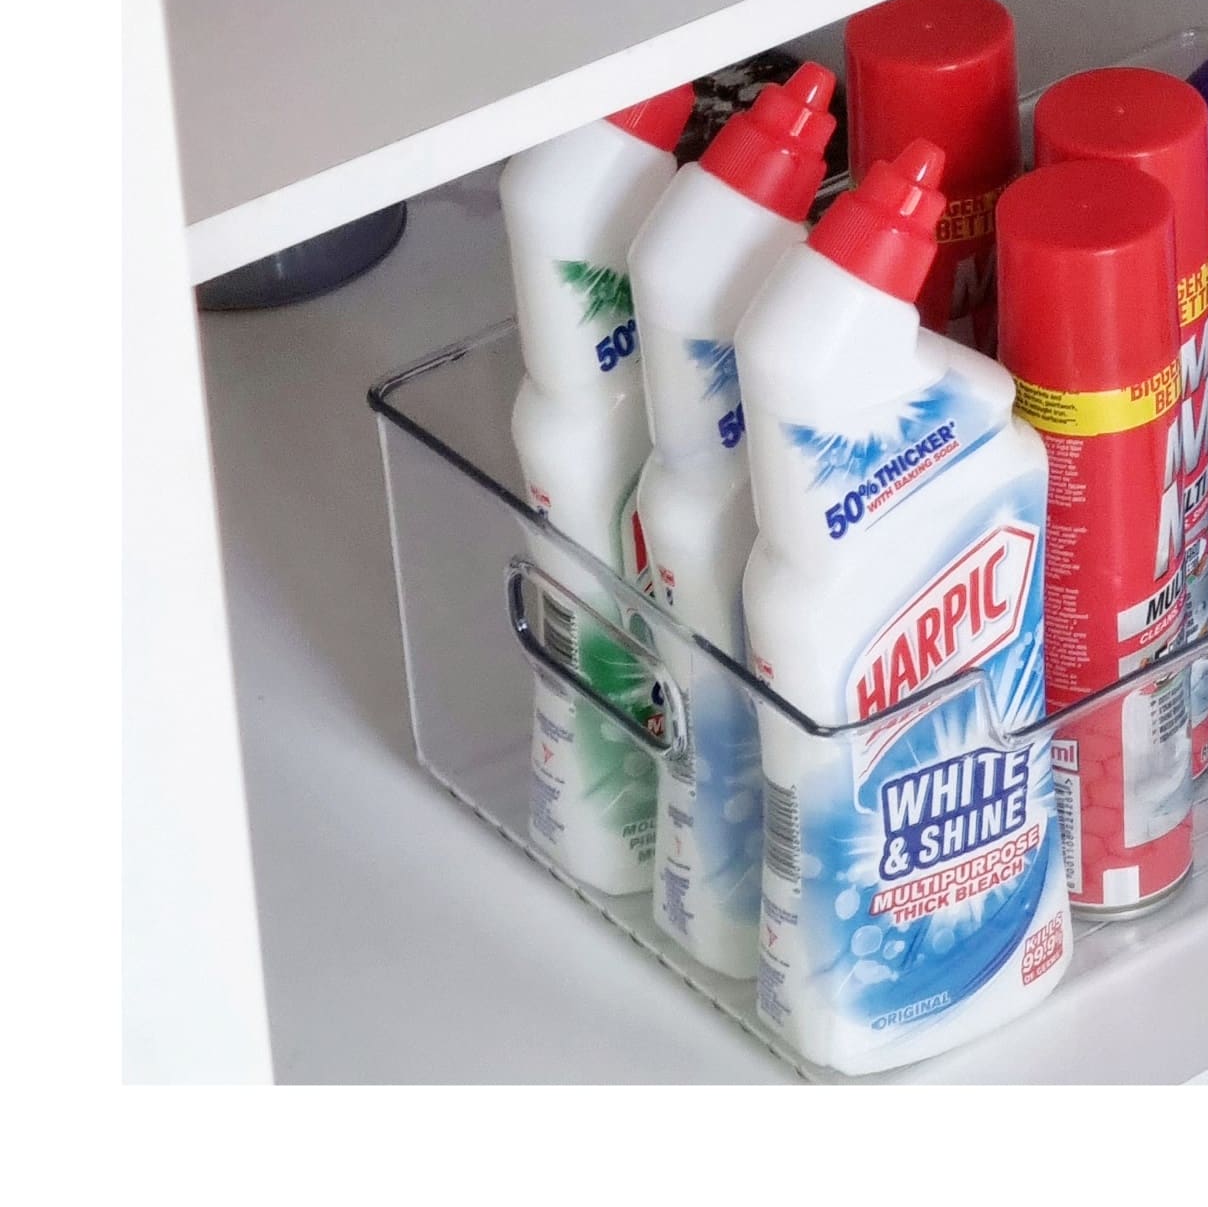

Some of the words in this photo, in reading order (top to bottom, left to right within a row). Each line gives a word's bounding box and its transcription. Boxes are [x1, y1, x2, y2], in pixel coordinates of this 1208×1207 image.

[825, 480, 878, 539] 50%
[867, 487, 894, 513] WITH
[894, 459, 932, 491] BAKING
[933, 440, 960, 463] SODA
[857, 545, 1007, 721] HARPIC
[887, 746, 1030, 833] WHITE
[871, 825, 1040, 915] MULTIPURPOSE
[883, 837, 910, 875] &
[919, 790, 1026, 864] SHINE
[893, 894, 950, 924] THICK
[955, 858, 1024, 903] BLEACH
[877, 992, 950, 1029] ORIGINAL
